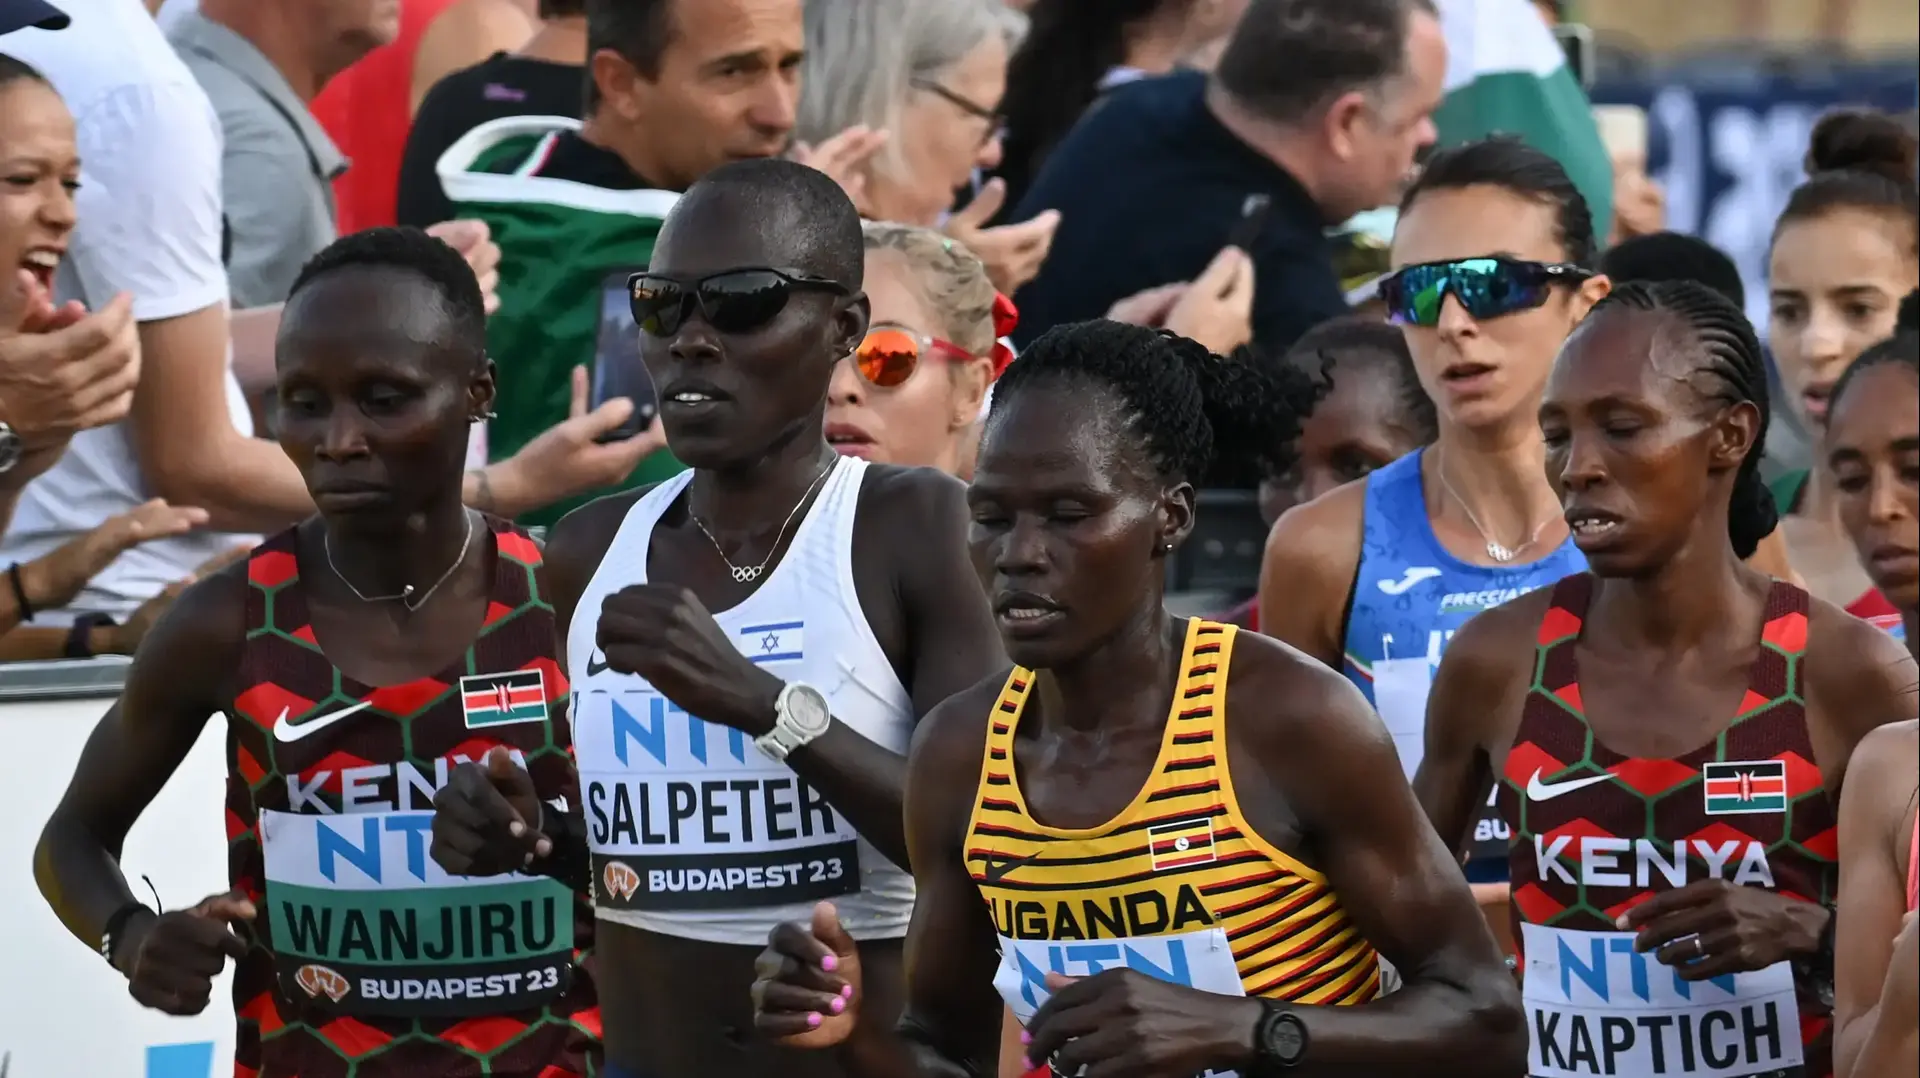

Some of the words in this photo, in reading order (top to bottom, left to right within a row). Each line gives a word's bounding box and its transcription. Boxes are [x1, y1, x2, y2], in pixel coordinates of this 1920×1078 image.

[1441, 587, 1542, 608] FRECCIA
[612, 697, 746, 768] NT
[286, 748, 528, 815] KEN
[588, 777, 836, 846] SALPETER
[316, 815, 515, 885] NT
[649, 863, 802, 892] BUDAPEST
[807, 858, 844, 883] 23
[1534, 834, 1775, 889] KENYA
[282, 897, 557, 961] WANJIRU
[991, 883, 1214, 941] UGANDA
[360, 972, 522, 1000] BUDAPEST
[525, 966, 559, 991] 23
[1534, 1001, 1782, 1077] KAPTICH
